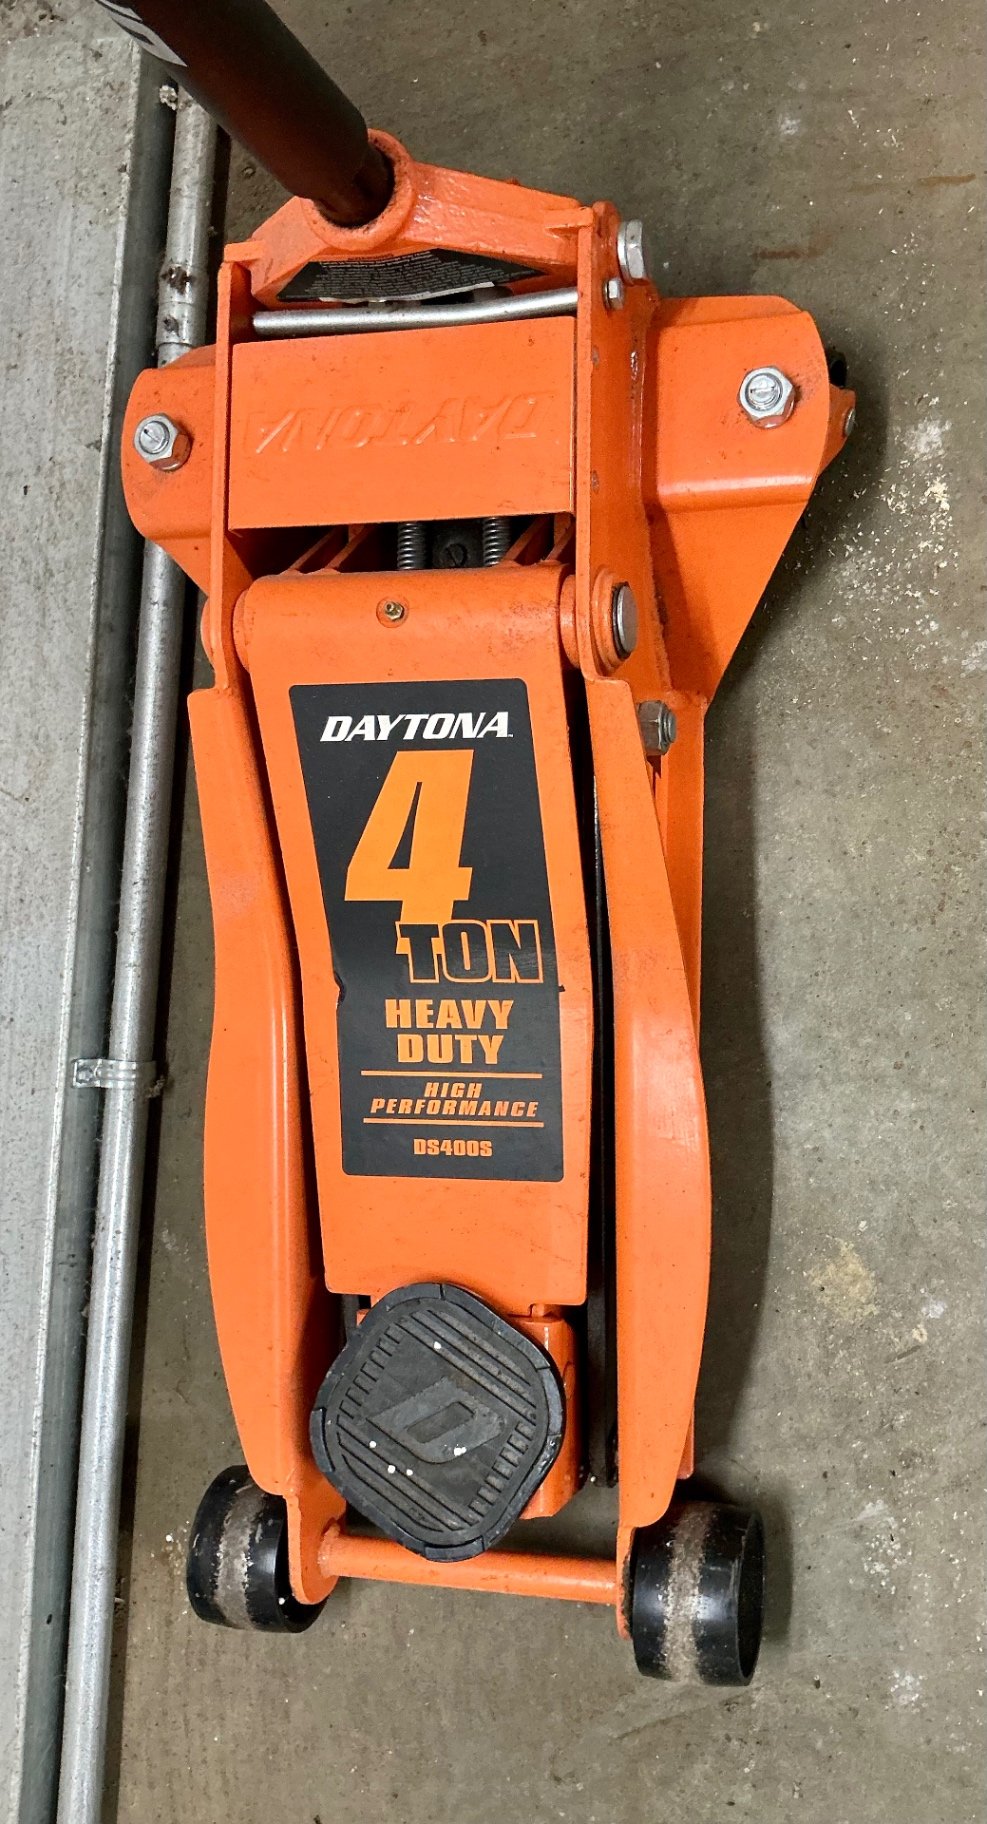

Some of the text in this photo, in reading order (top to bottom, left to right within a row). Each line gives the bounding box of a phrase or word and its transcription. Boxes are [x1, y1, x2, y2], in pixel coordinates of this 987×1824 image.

[320, 711, 509, 742] DAYTONA
[344, 749, 474, 954] 4
[396, 920, 543, 984] TON
[385, 999, 514, 1029] HEAVY
[397, 1033, 504, 1064] DUTY
[424, 1082, 482, 1098] HIGH
[370, 1098, 539, 1117] PERFORMANCE
[413, 1139, 493, 1158] DS400S
